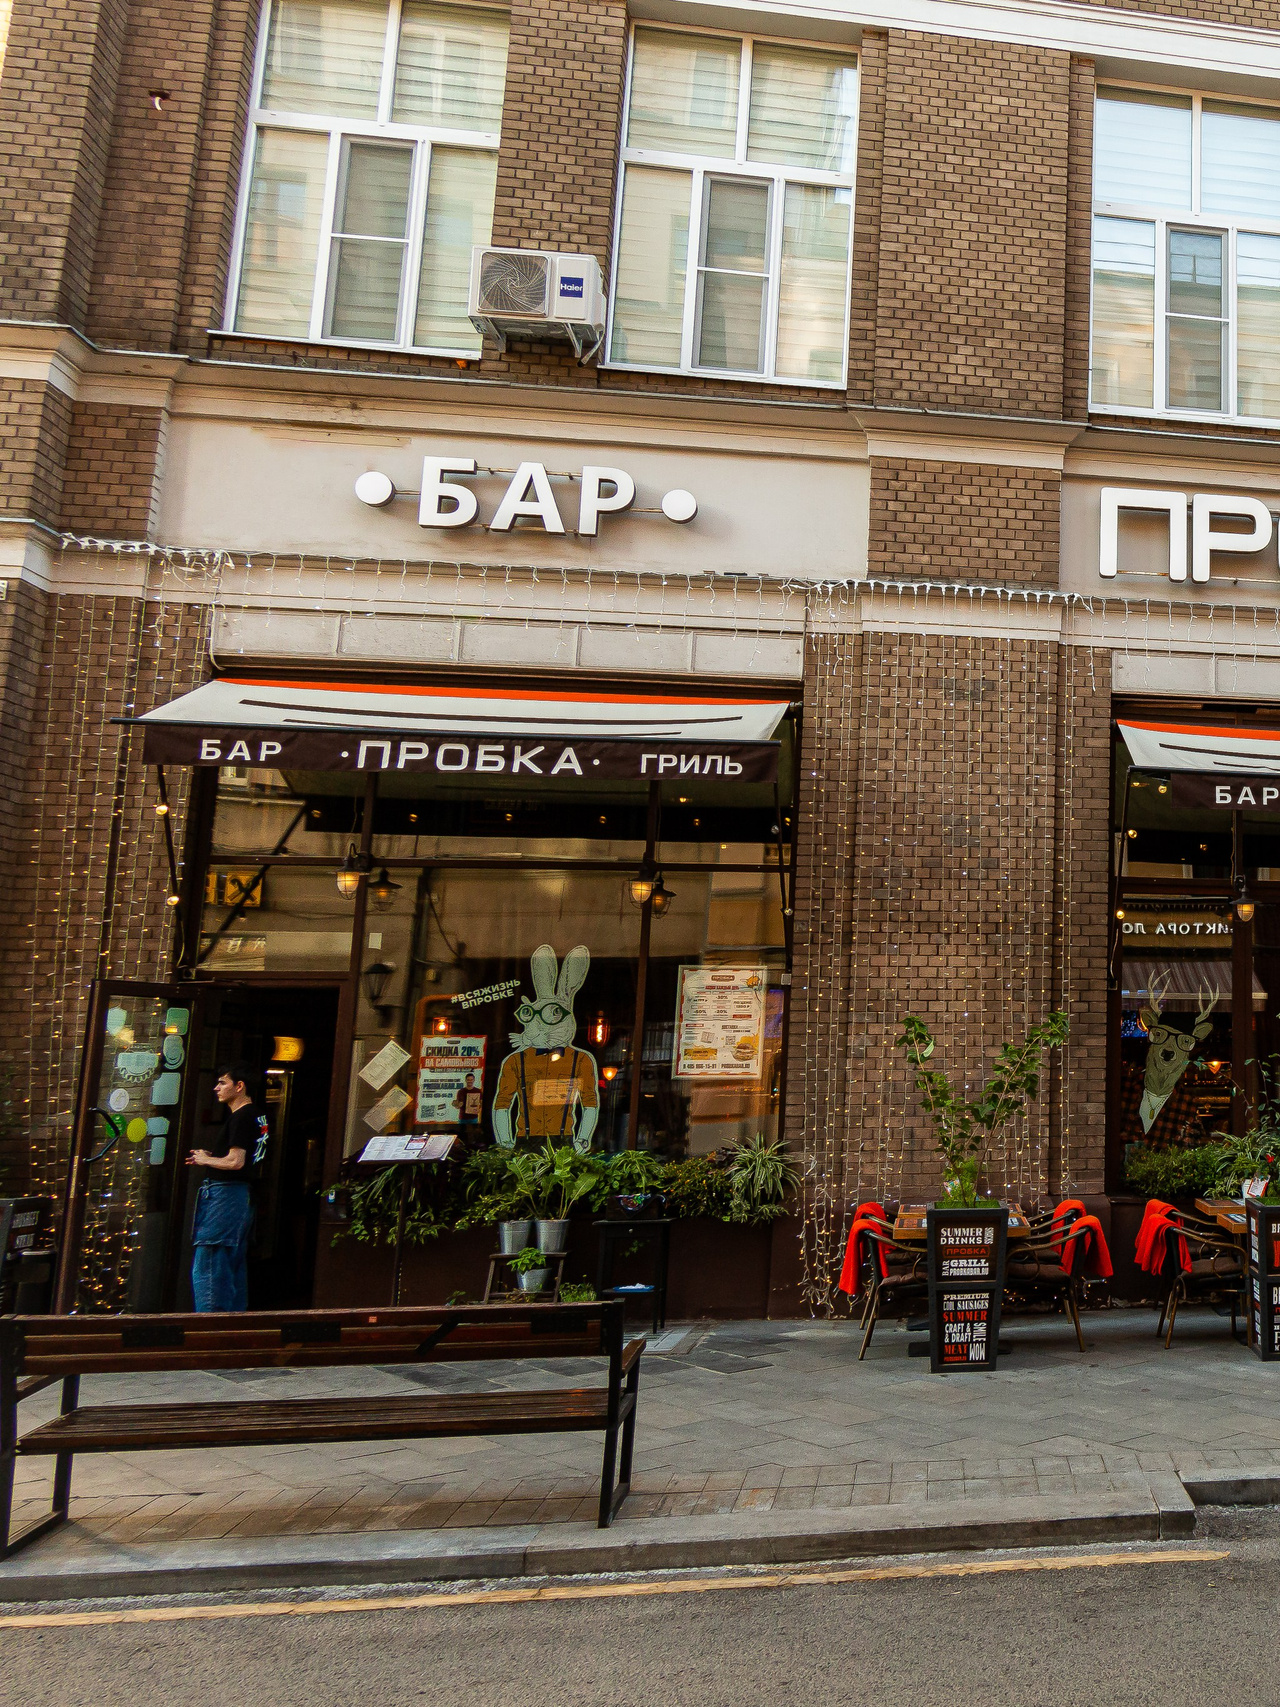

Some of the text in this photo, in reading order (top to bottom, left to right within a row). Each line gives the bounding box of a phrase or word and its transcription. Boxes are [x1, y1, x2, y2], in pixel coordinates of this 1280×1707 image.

[560, 283, 583, 292] Haier
[418, 455, 637, 537] БАР
[199, 738, 743, 776] БАР ПРОБКА ГРИЛЬ
[1215, 785, 1280, 806] БАР
[450, 979, 521, 1004] #ВСЯЖИЗНЬ
[461, 988, 515, 1010] ВПРОБКЕ
[426, 1046, 480, 1058] СКИДКА 20%
[425, 1058, 480, 1067] НА САМОВЫВОЗ
[940, 1227, 983, 1237] SUMMER
[940, 1237, 983, 1245] DRINKS
[942, 1260, 950, 1276] BAR
[950, 1259, 989, 1268] GRILL
[943, 1292, 990, 1300] PREMIUM
[956, 1299, 989, 1311] SAUSAGES
[942, 1310, 988, 1323] SUMMER
[944, 1322, 971, 1333] CRAFT &
[972, 1322, 987, 1342] SMILE
[944, 1333, 972, 1343] & DRAFT
[944, 1344, 968, 1355] MEAT
[969, 1342, 986, 1361] WOW
